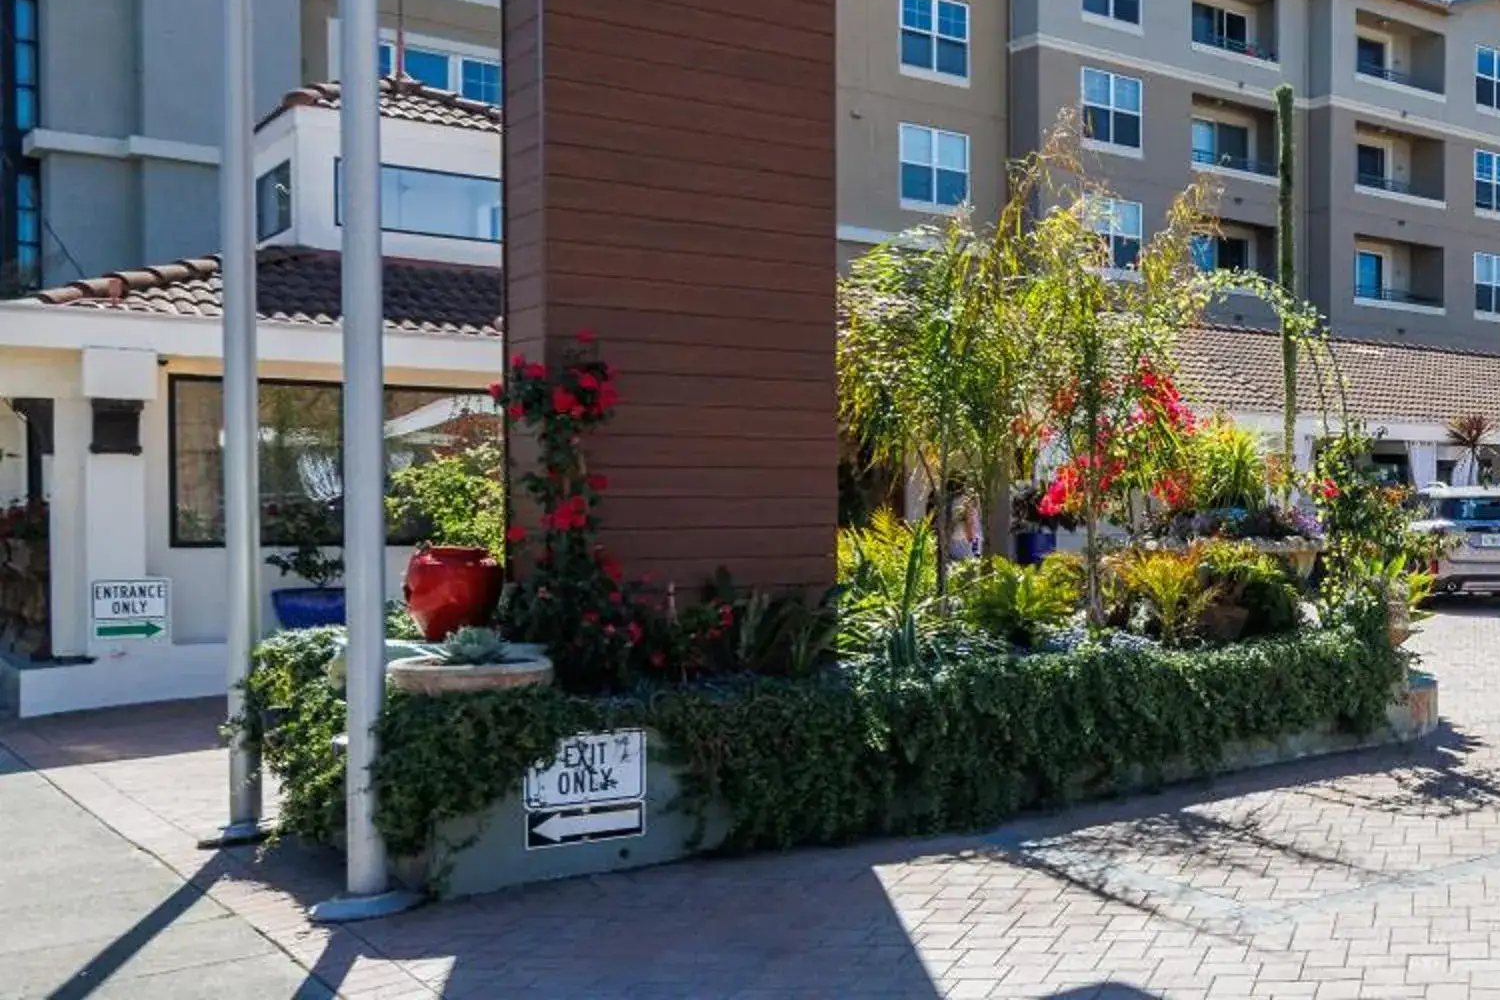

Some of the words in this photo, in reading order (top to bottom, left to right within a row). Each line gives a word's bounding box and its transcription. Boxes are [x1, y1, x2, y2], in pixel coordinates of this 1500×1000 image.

[95, 585, 168, 600] ENTRANCE
[111, 600, 147, 614] ONLY
[564, 741, 607, 768] EXIT
[558, 767, 614, 795] ONLY
